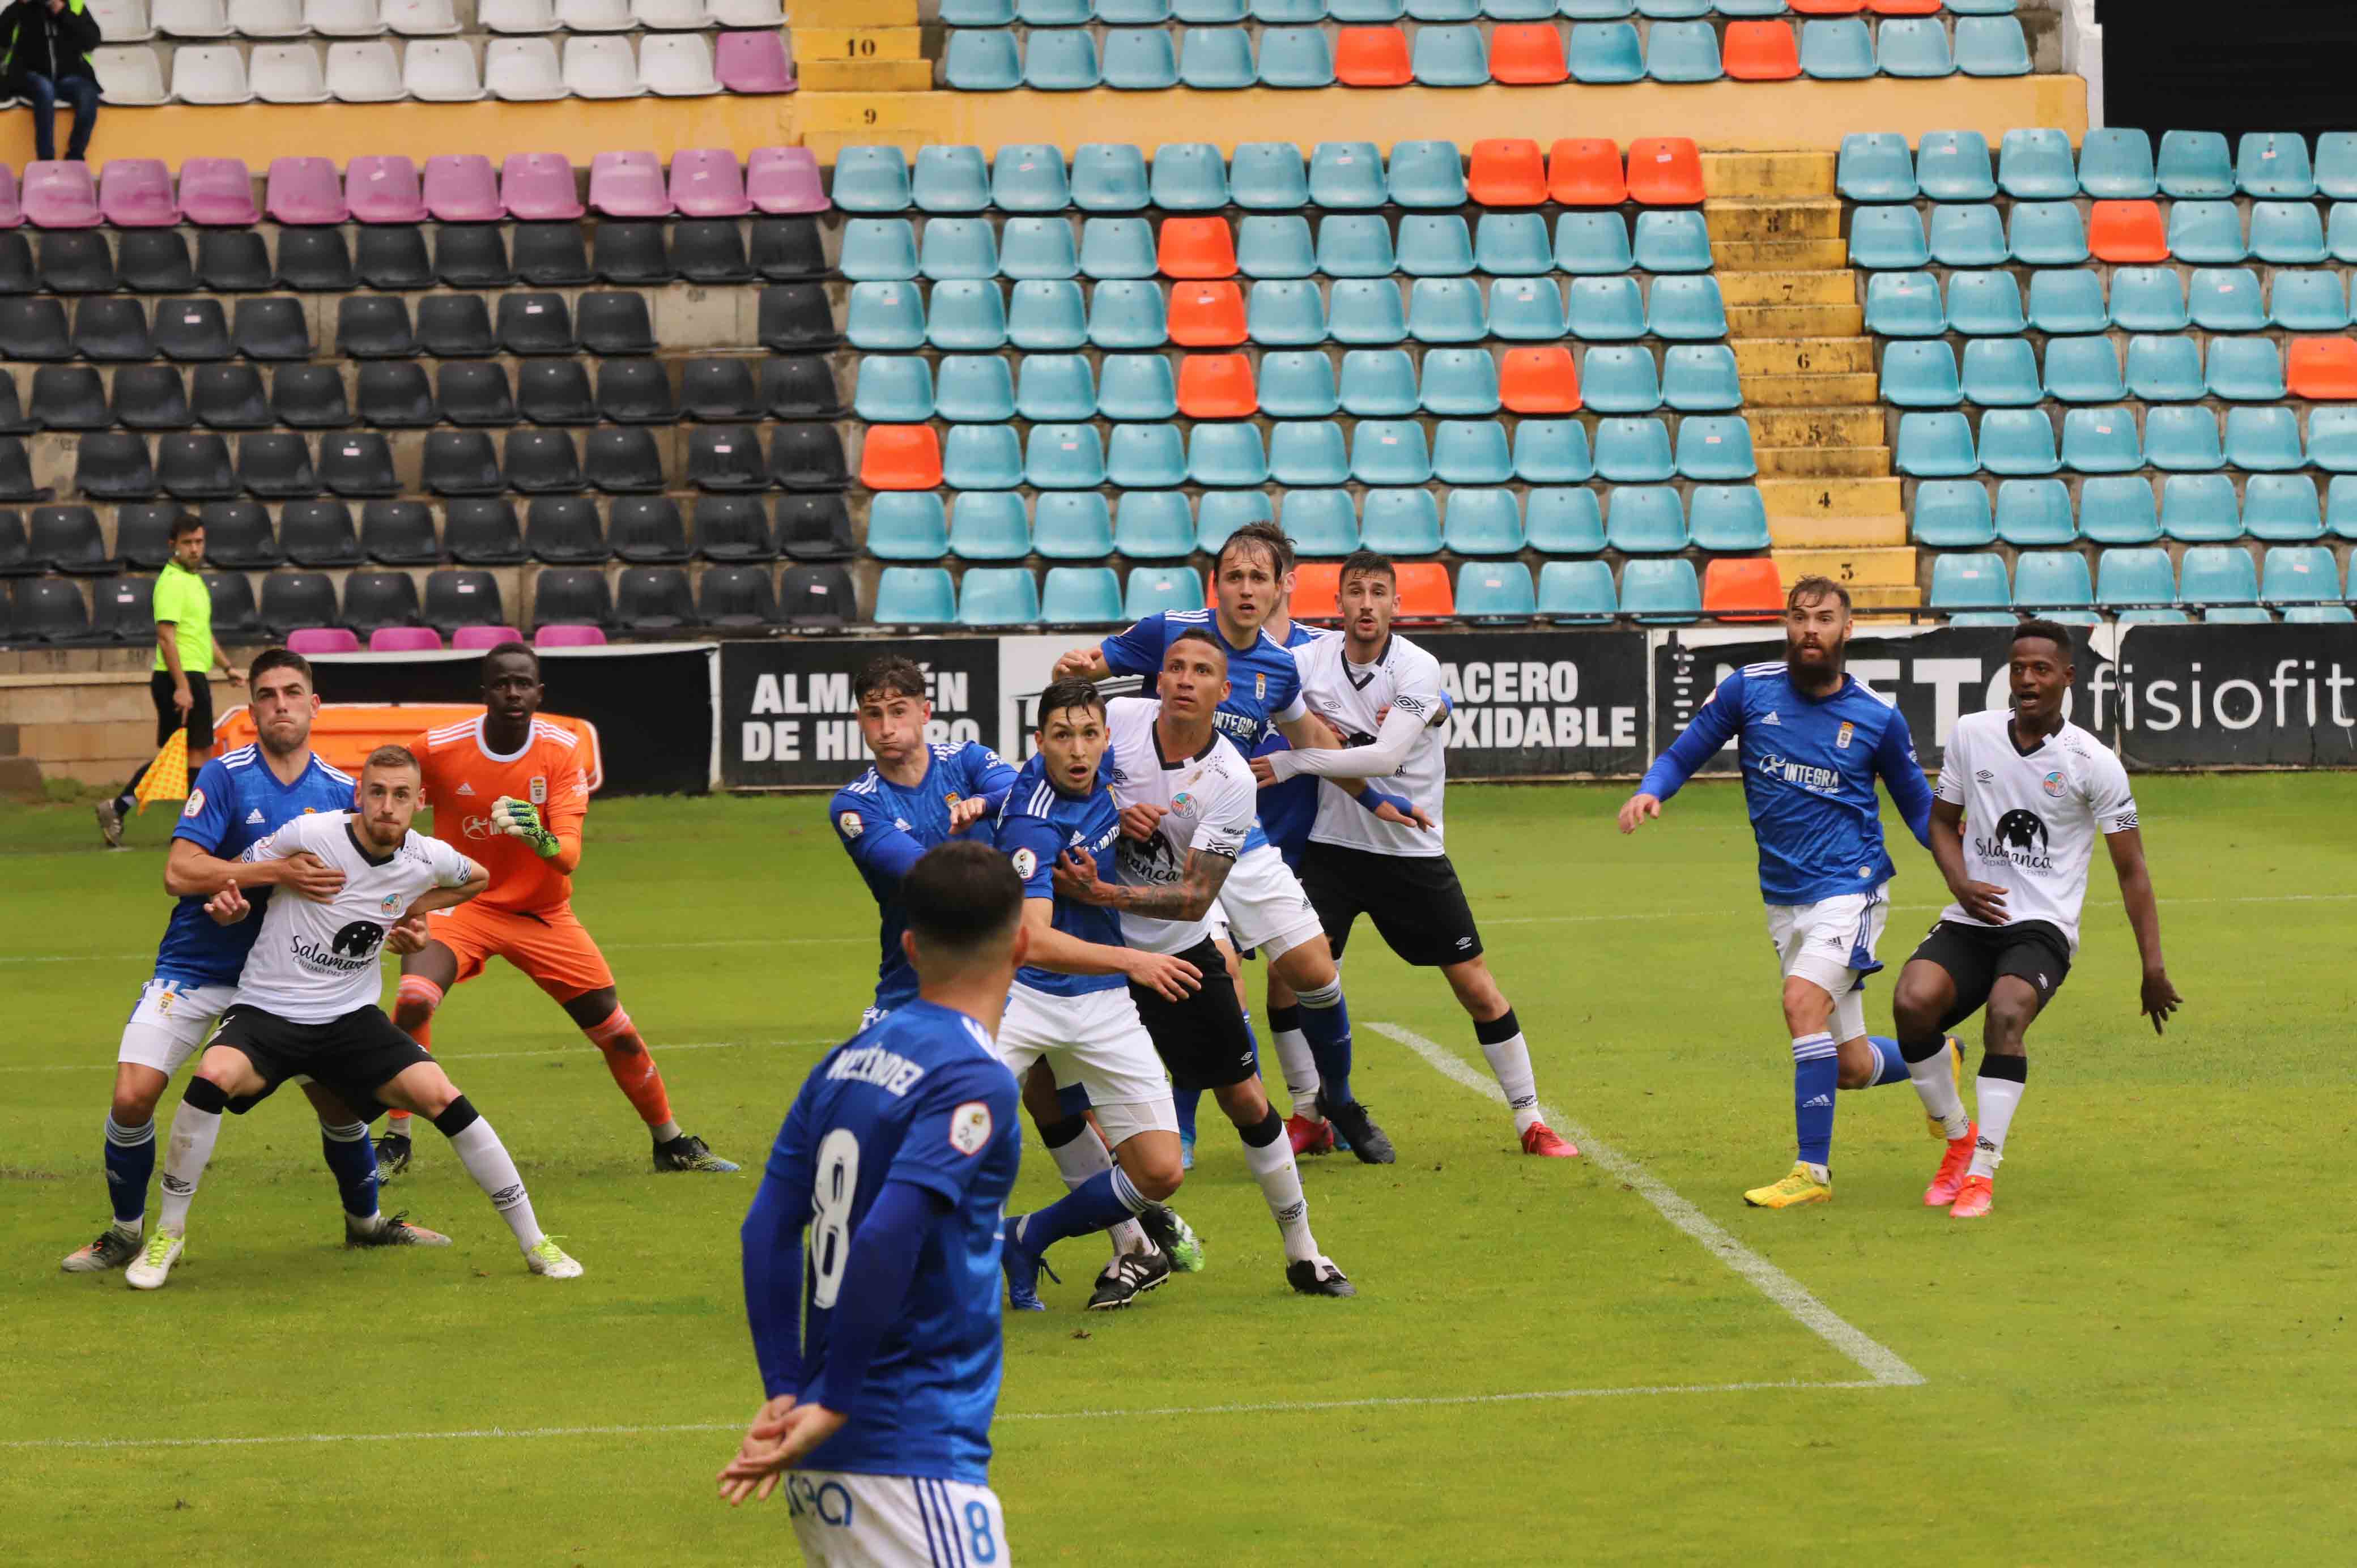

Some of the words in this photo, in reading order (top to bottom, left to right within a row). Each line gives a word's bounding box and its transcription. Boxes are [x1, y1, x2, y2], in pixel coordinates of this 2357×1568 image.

[846, 39, 876, 57] 10
[863, 108, 877, 125] 9
[1782, 284, 1794, 301] 7
[1797, 353, 1810, 369] 6
[1809, 424, 1822, 441] 5
[1818, 492, 1831, 508] 4
[1840, 563, 1854, 580] 3
[751, 662, 968, 714] ALMÉN
[1440, 661, 1579, 703] ACERO
[2087, 659, 2355, 731] fisiofit
[742, 721, 801, 761] DE
[816, 718, 980, 761] HIRO
[1785, 763, 1839, 787] INTEGRA
[811, 1127, 860, 1310] 8
[964, 1500, 997, 1564] 8
